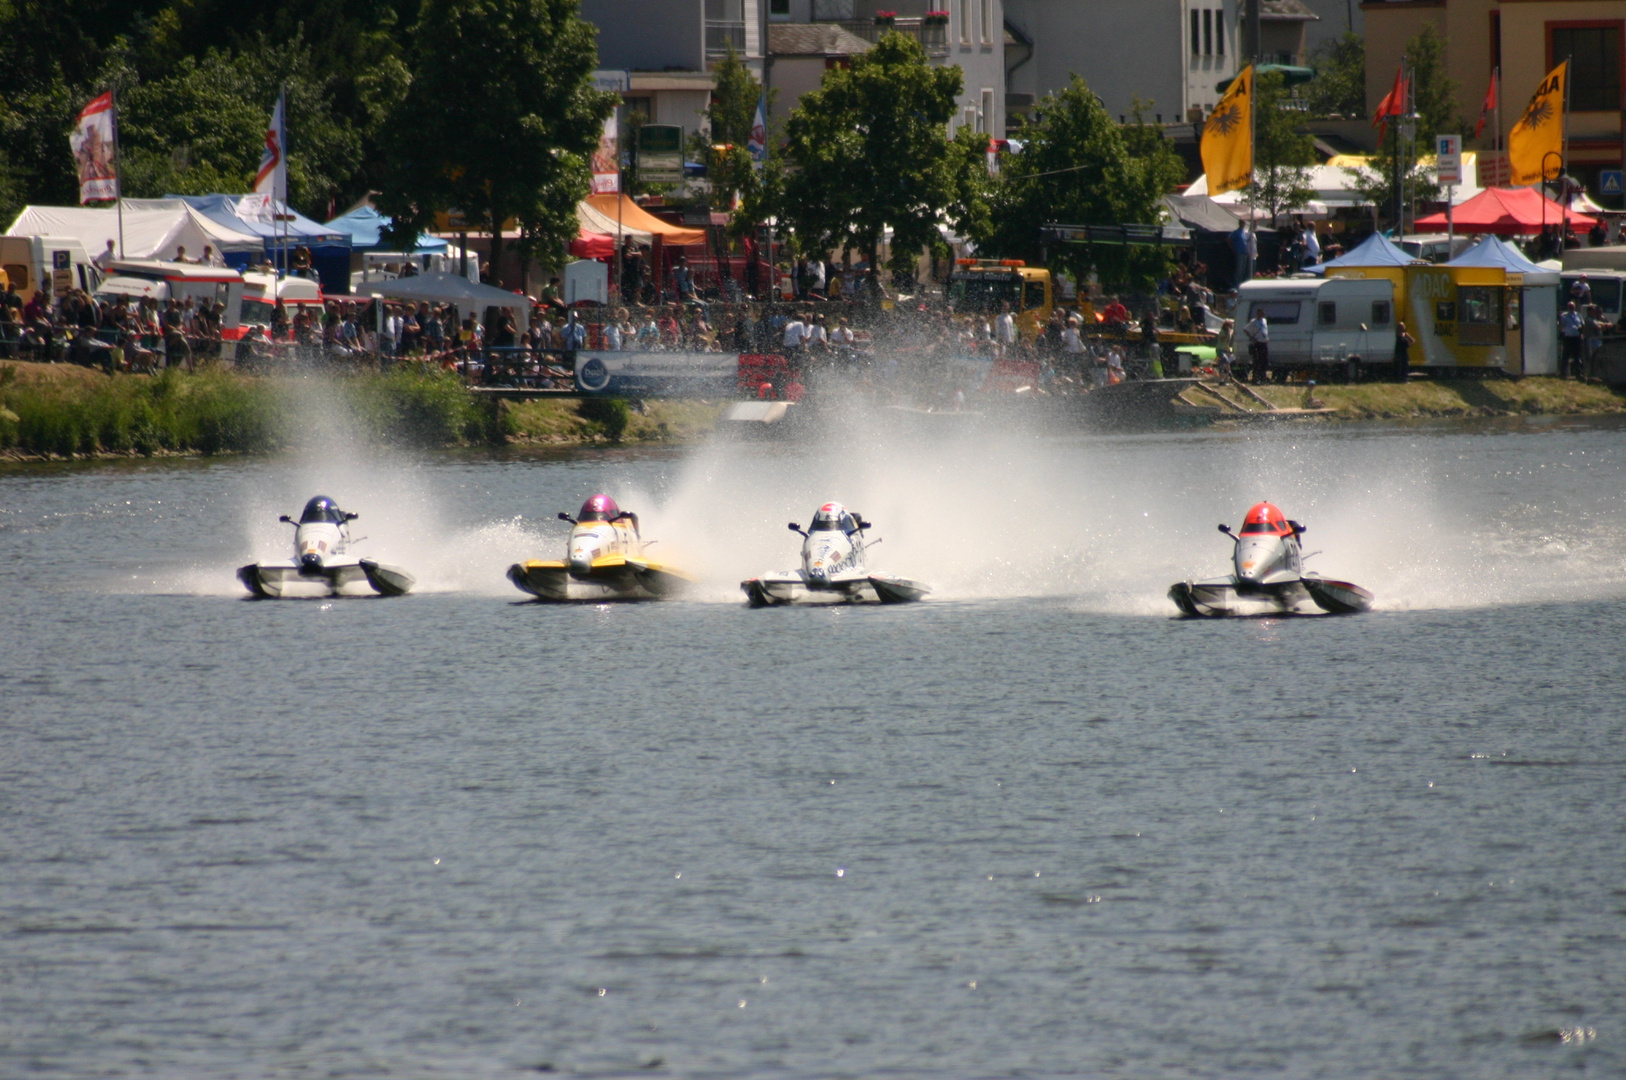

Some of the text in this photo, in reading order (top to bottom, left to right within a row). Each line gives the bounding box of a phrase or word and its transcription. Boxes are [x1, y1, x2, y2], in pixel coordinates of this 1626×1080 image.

[57, 253, 66, 267] P
[1412, 273, 1450, 298] ADAC
[1434, 323, 1454, 337] ADAC
